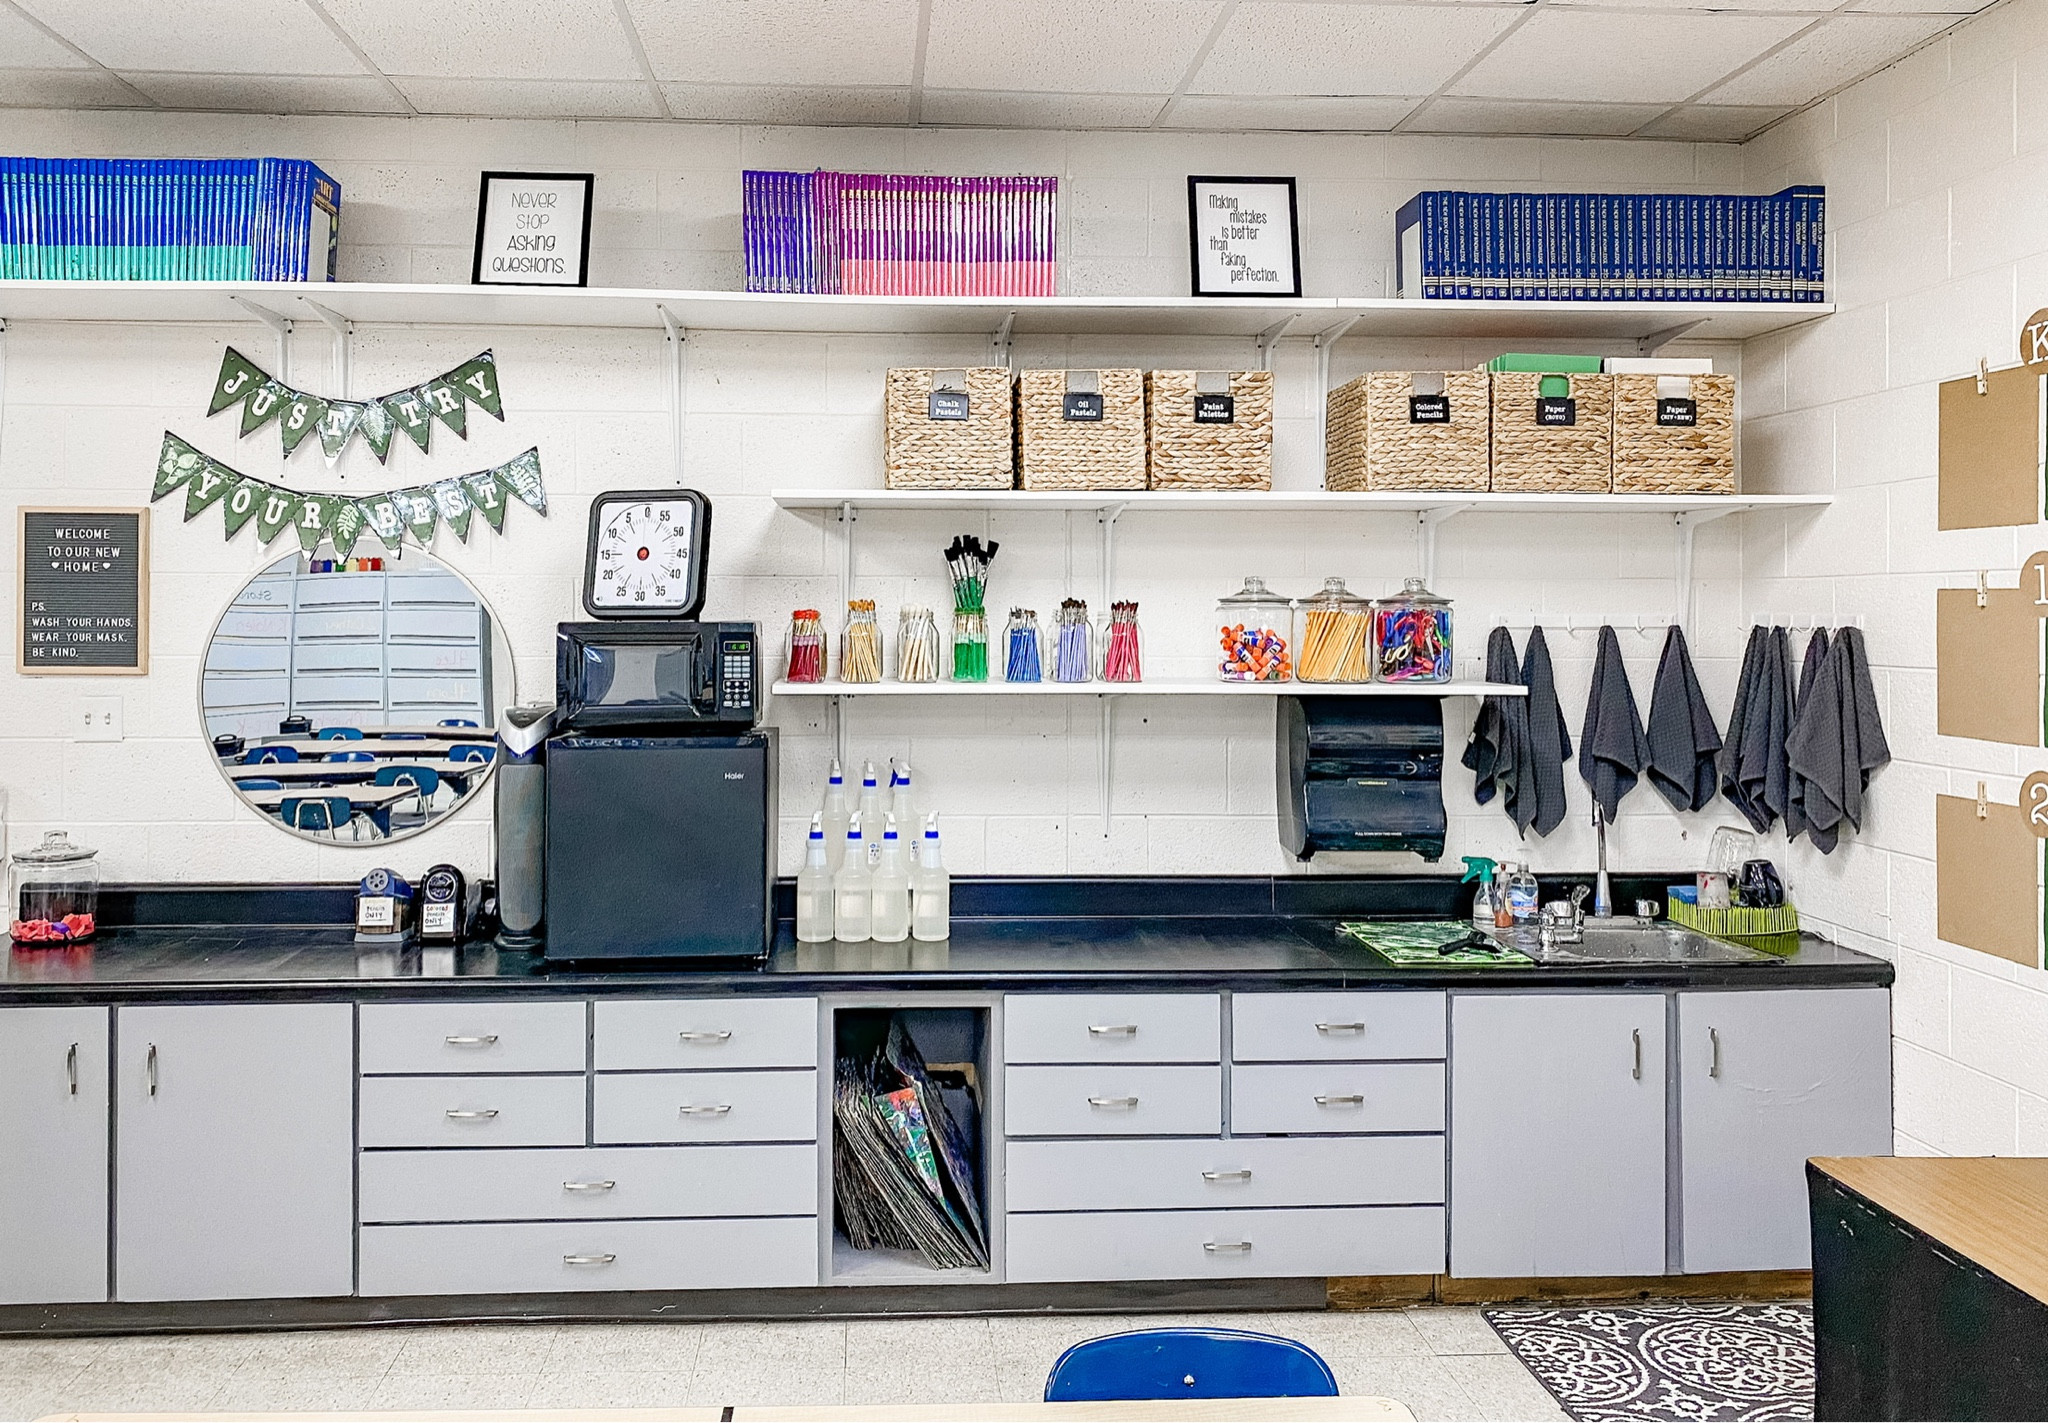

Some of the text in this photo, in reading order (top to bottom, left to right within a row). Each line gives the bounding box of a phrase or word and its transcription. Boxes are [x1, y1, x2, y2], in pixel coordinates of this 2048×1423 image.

[1209, 194, 1238, 212] Making
[1229, 209, 1267, 224] mistakes
[1231, 224, 1260, 240] better
[1209, 235, 1228, 251] than
[1220, 251, 1246, 269] faking
[1231, 267, 1280, 284] perfection.
[2027, 321, 2048, 365] K
[224, 369, 492, 436] JUST TRY
[1077, 400, 1089, 408] Oil
[1203, 402, 1224, 410] Paint
[1070, 408, 1097, 417] Pastels
[1198, 410, 1229, 418] Palettes
[1416, 411, 1444, 419] Pencils
[1544, 405, 1566, 414] Paper
[1666, 405, 1688, 414] Paper
[193, 470, 499, 530] YOUR BEST
[625, 512, 632, 524] 5
[644, 506, 651, 518] 0
[659, 510, 671, 522] 55
[55, 528, 111, 540] WELCOME
[608, 528, 617, 539] 10
[673, 526, 684, 537] 50
[47, 546, 120, 558] TO OUR NEW
[601, 549, 611, 560] 15
[676, 548, 688, 559] 45
[63, 561, 99, 573] HOME
[602, 569, 614, 580] 20
[669, 568, 681, 579] 40
[2034, 564, 2048, 605] 1
[616, 585, 627, 597] 25
[634, 590, 645, 602] 30
[655, 585, 666, 597] 35
[31, 601, 47, 612] P.S.
[31, 617, 134, 628] WASH YOUR HANDS.
[31, 632, 128, 642] WEAR YOUR MASK.
[32, 647, 79, 658] BE KIND.
[724, 772, 745, 780] Haier
[2030, 783, 2048, 825] 2
